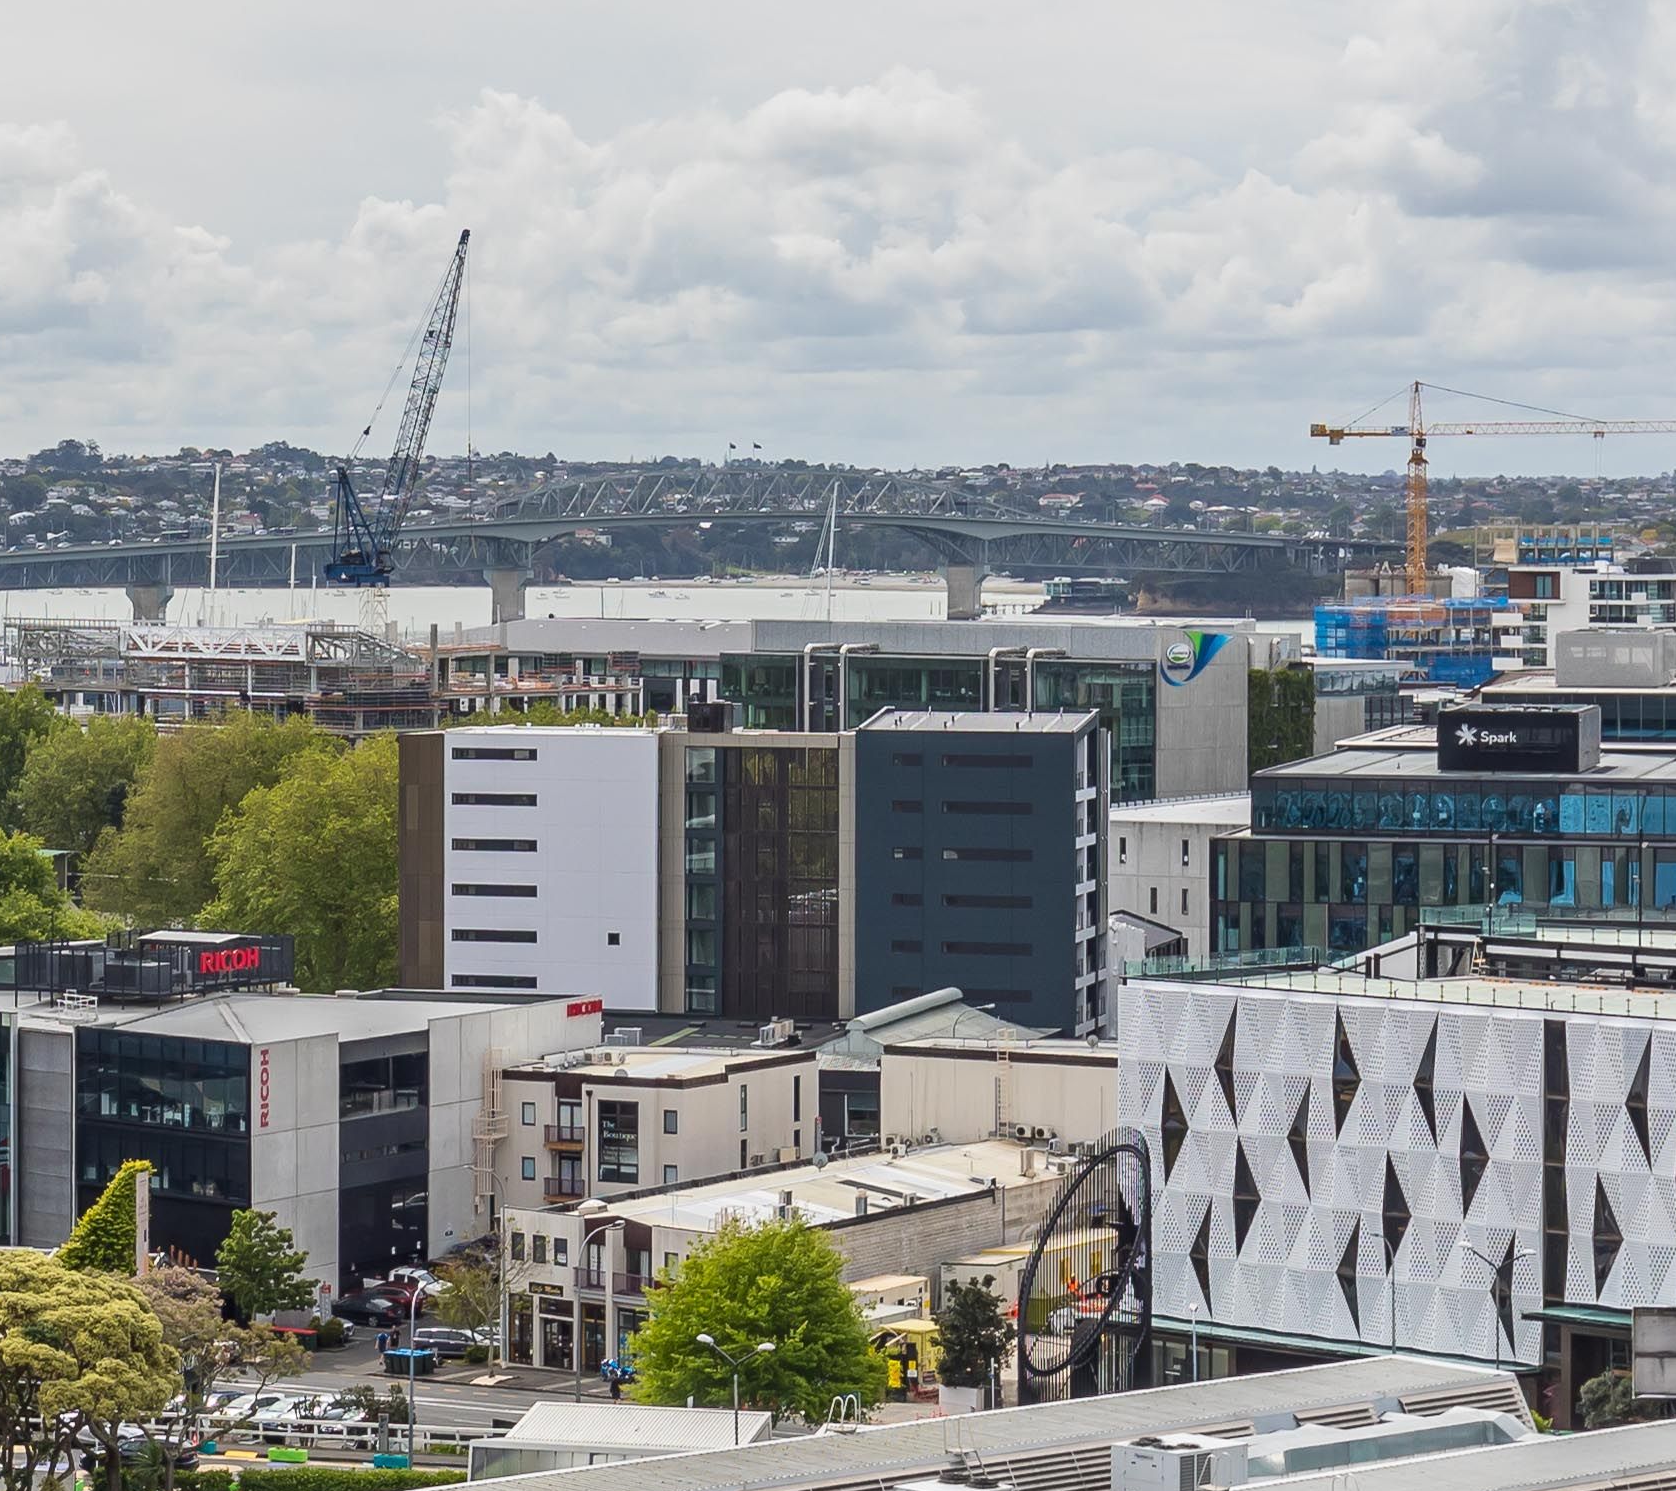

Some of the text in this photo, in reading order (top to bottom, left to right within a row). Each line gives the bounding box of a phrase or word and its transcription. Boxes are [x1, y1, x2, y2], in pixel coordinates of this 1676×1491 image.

[1480, 730, 1517, 745] Spark
[199, 946, 260, 974] RICOH
[260, 1048, 270, 1128] RICOH
